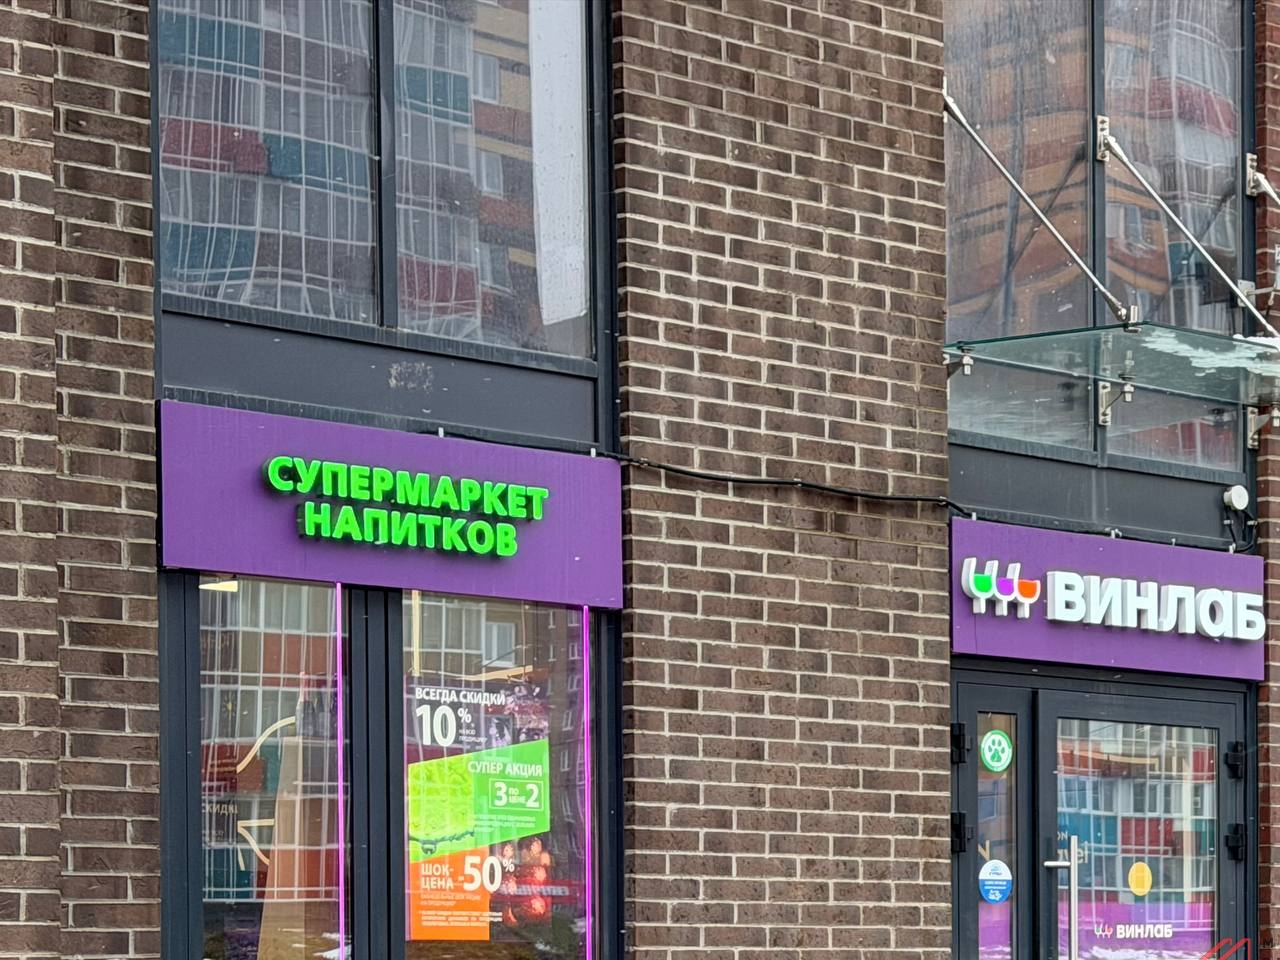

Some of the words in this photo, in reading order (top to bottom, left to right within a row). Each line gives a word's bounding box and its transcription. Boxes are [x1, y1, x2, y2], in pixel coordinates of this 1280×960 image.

[266, 455, 549, 521] СУПЕРМАРКЕТ
[303, 500, 518, 558] НАПИТКОВ
[415, 687, 458, 704] ВСЕГДА
[459, 690, 506, 706] СКИДКИ
[467, 760, 503, 774] СУПЕР
[505, 763, 543, 778] АКЦИЯ
[494, 781, 508, 807] 3
[525, 783, 540, 808] 2
[421, 863, 454, 876] ШОК-
[421, 876, 454, 891] ЦЕНА
